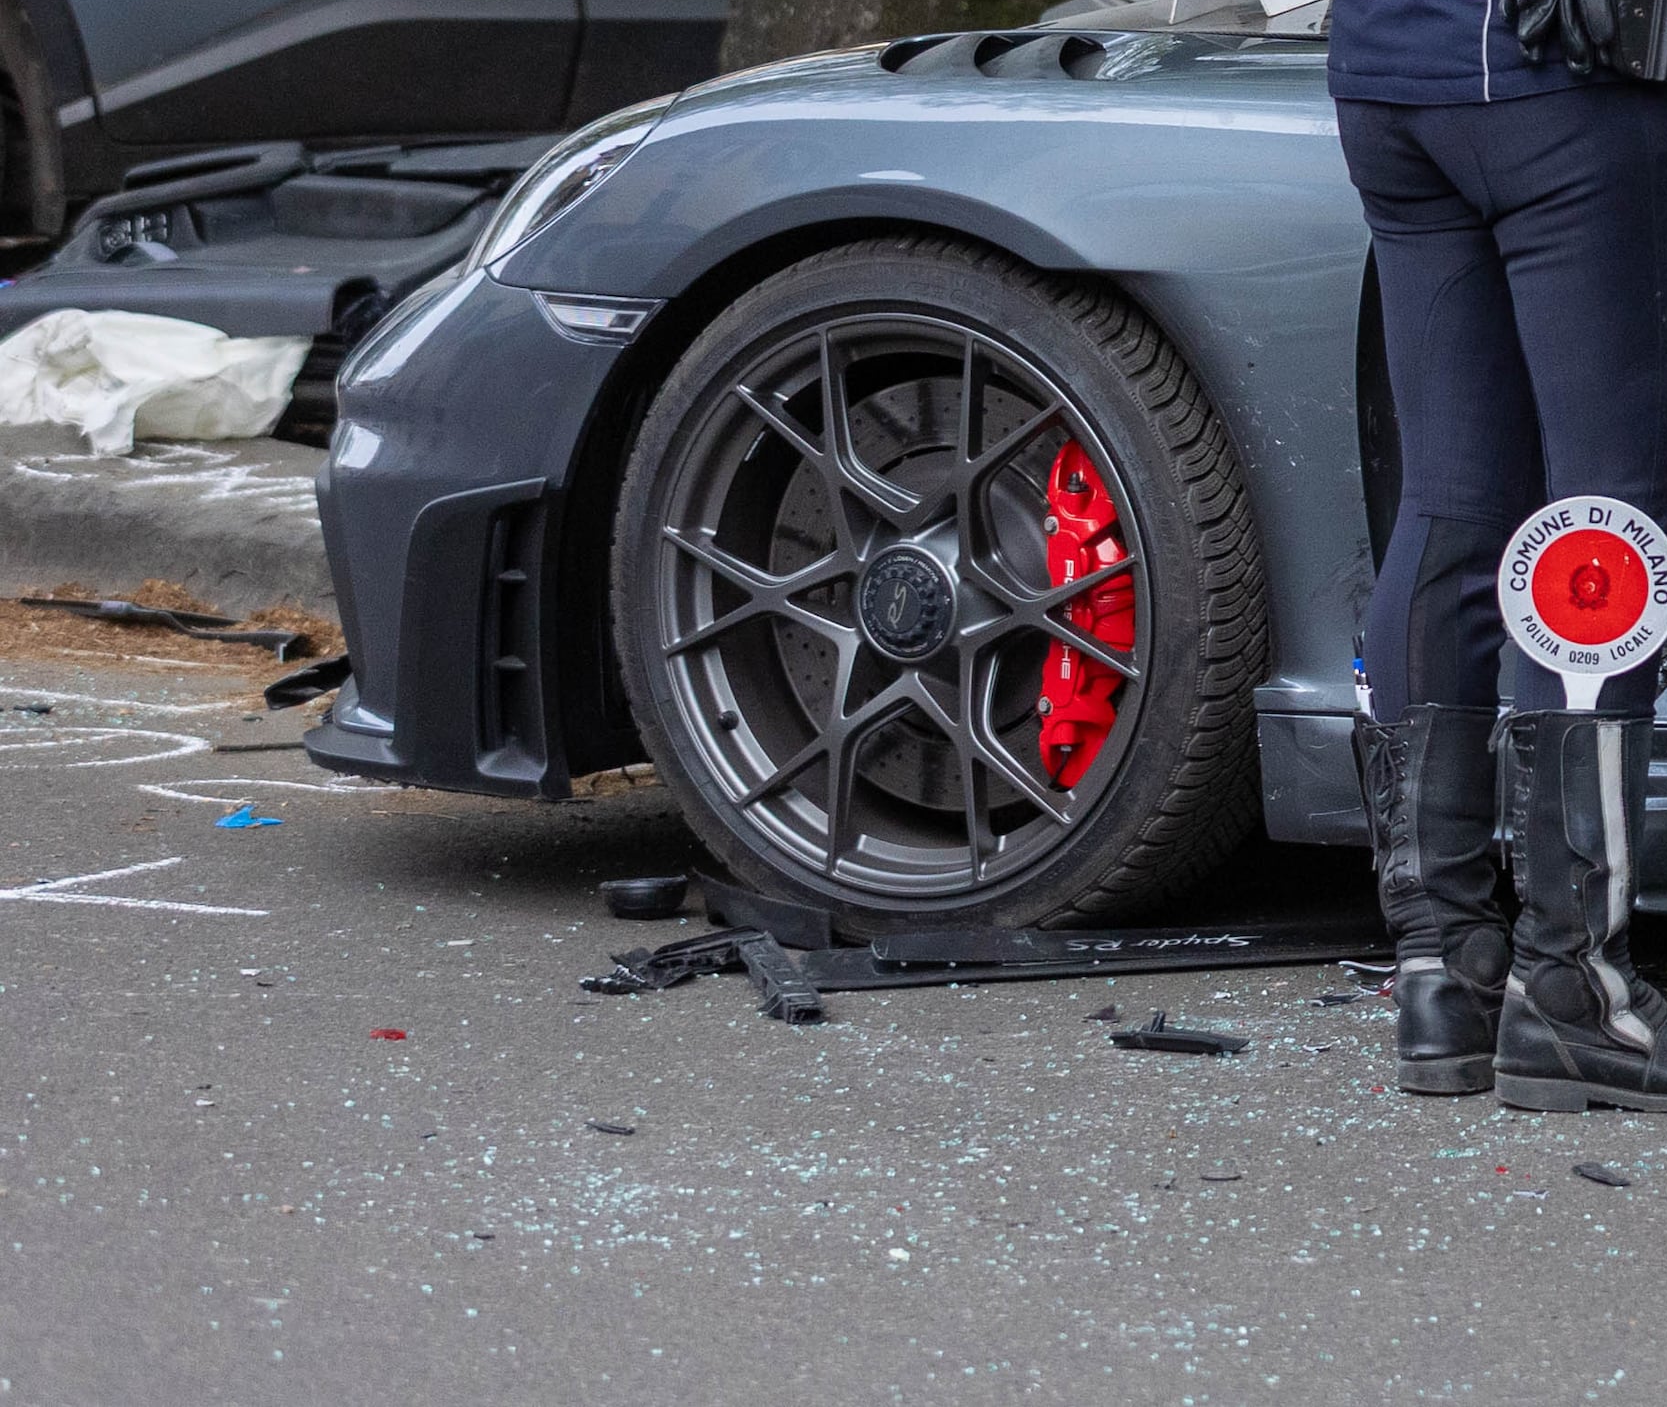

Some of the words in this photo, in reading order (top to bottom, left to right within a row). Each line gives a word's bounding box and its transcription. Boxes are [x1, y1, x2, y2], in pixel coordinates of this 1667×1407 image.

[1509, 509, 1575, 592] COMUNE
[1588, 506, 1612, 527] DI
[1520, 614, 1562, 657] POLIZIA
[1568, 650, 1601, 666] 0209
[1609, 624, 1655, 662] LOCALE
[1065, 938, 1124, 951] RS
[1132, 933, 1264, 950] Spyder
